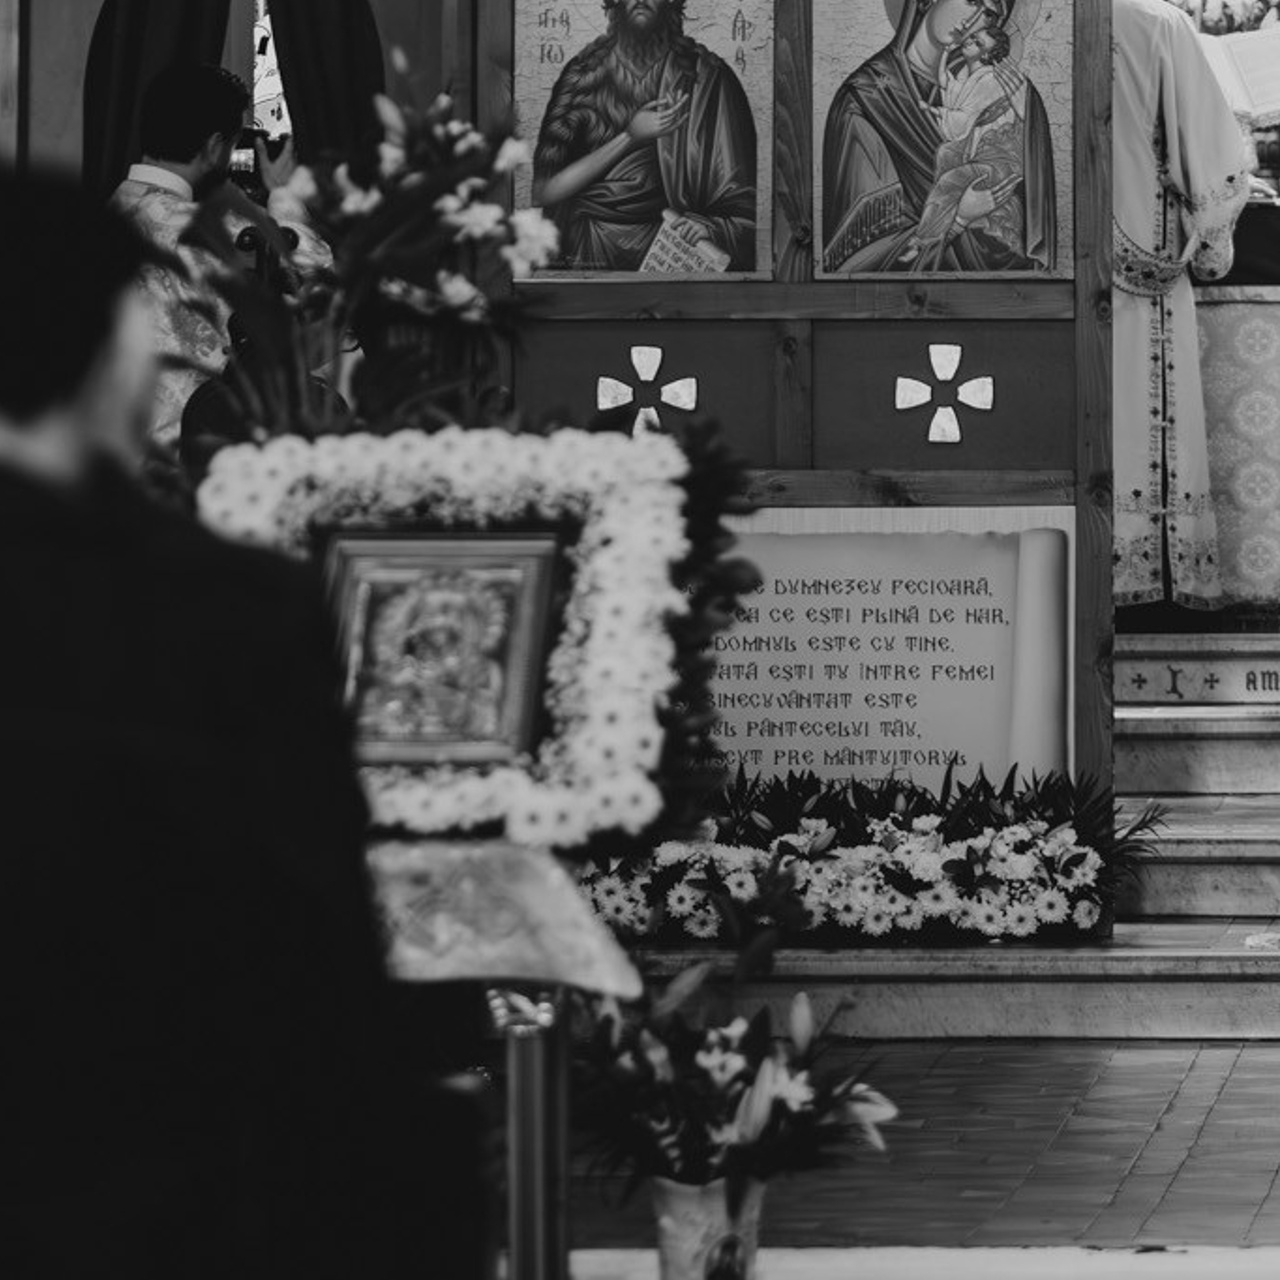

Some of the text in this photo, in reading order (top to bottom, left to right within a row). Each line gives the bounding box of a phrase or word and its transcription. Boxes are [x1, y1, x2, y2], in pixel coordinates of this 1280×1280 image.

[769, 607, 795, 623] CE
[929, 608, 955, 623] DE
[808, 636, 861, 652] ESTE
[932, 665, 994, 680] FEMEI
[1245, 669, 1280, 692] am
[864, 693, 918, 708] ESTE
[774, 749, 814, 766] PRE
